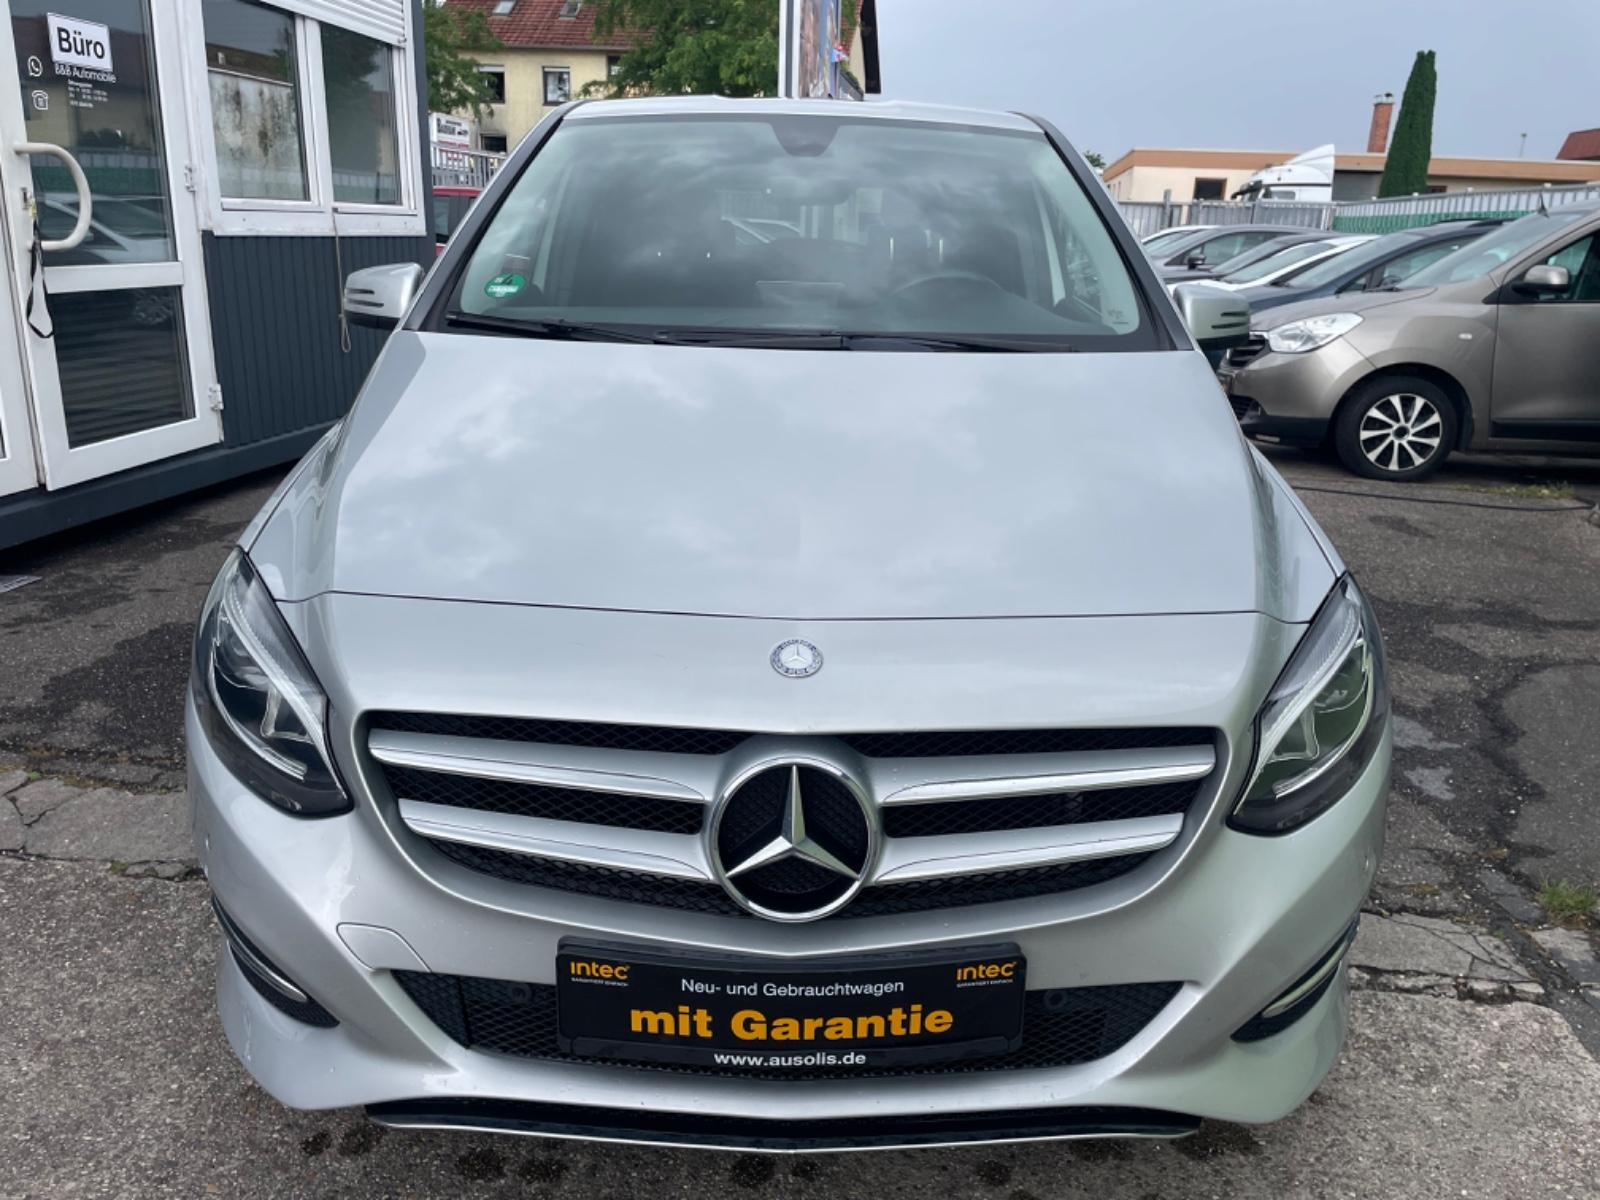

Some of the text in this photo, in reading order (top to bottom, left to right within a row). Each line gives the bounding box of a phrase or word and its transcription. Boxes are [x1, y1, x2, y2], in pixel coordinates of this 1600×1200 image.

[57, 27, 105, 59] Büro
[73, 67, 117, 83] Automobile
[681, 979, 904, 997] Neu- und Gebrauchtwagen
[630, 1004, 954, 1041] mit Garantie
[713, 1052, 867, 1067] www.ausolis.de
